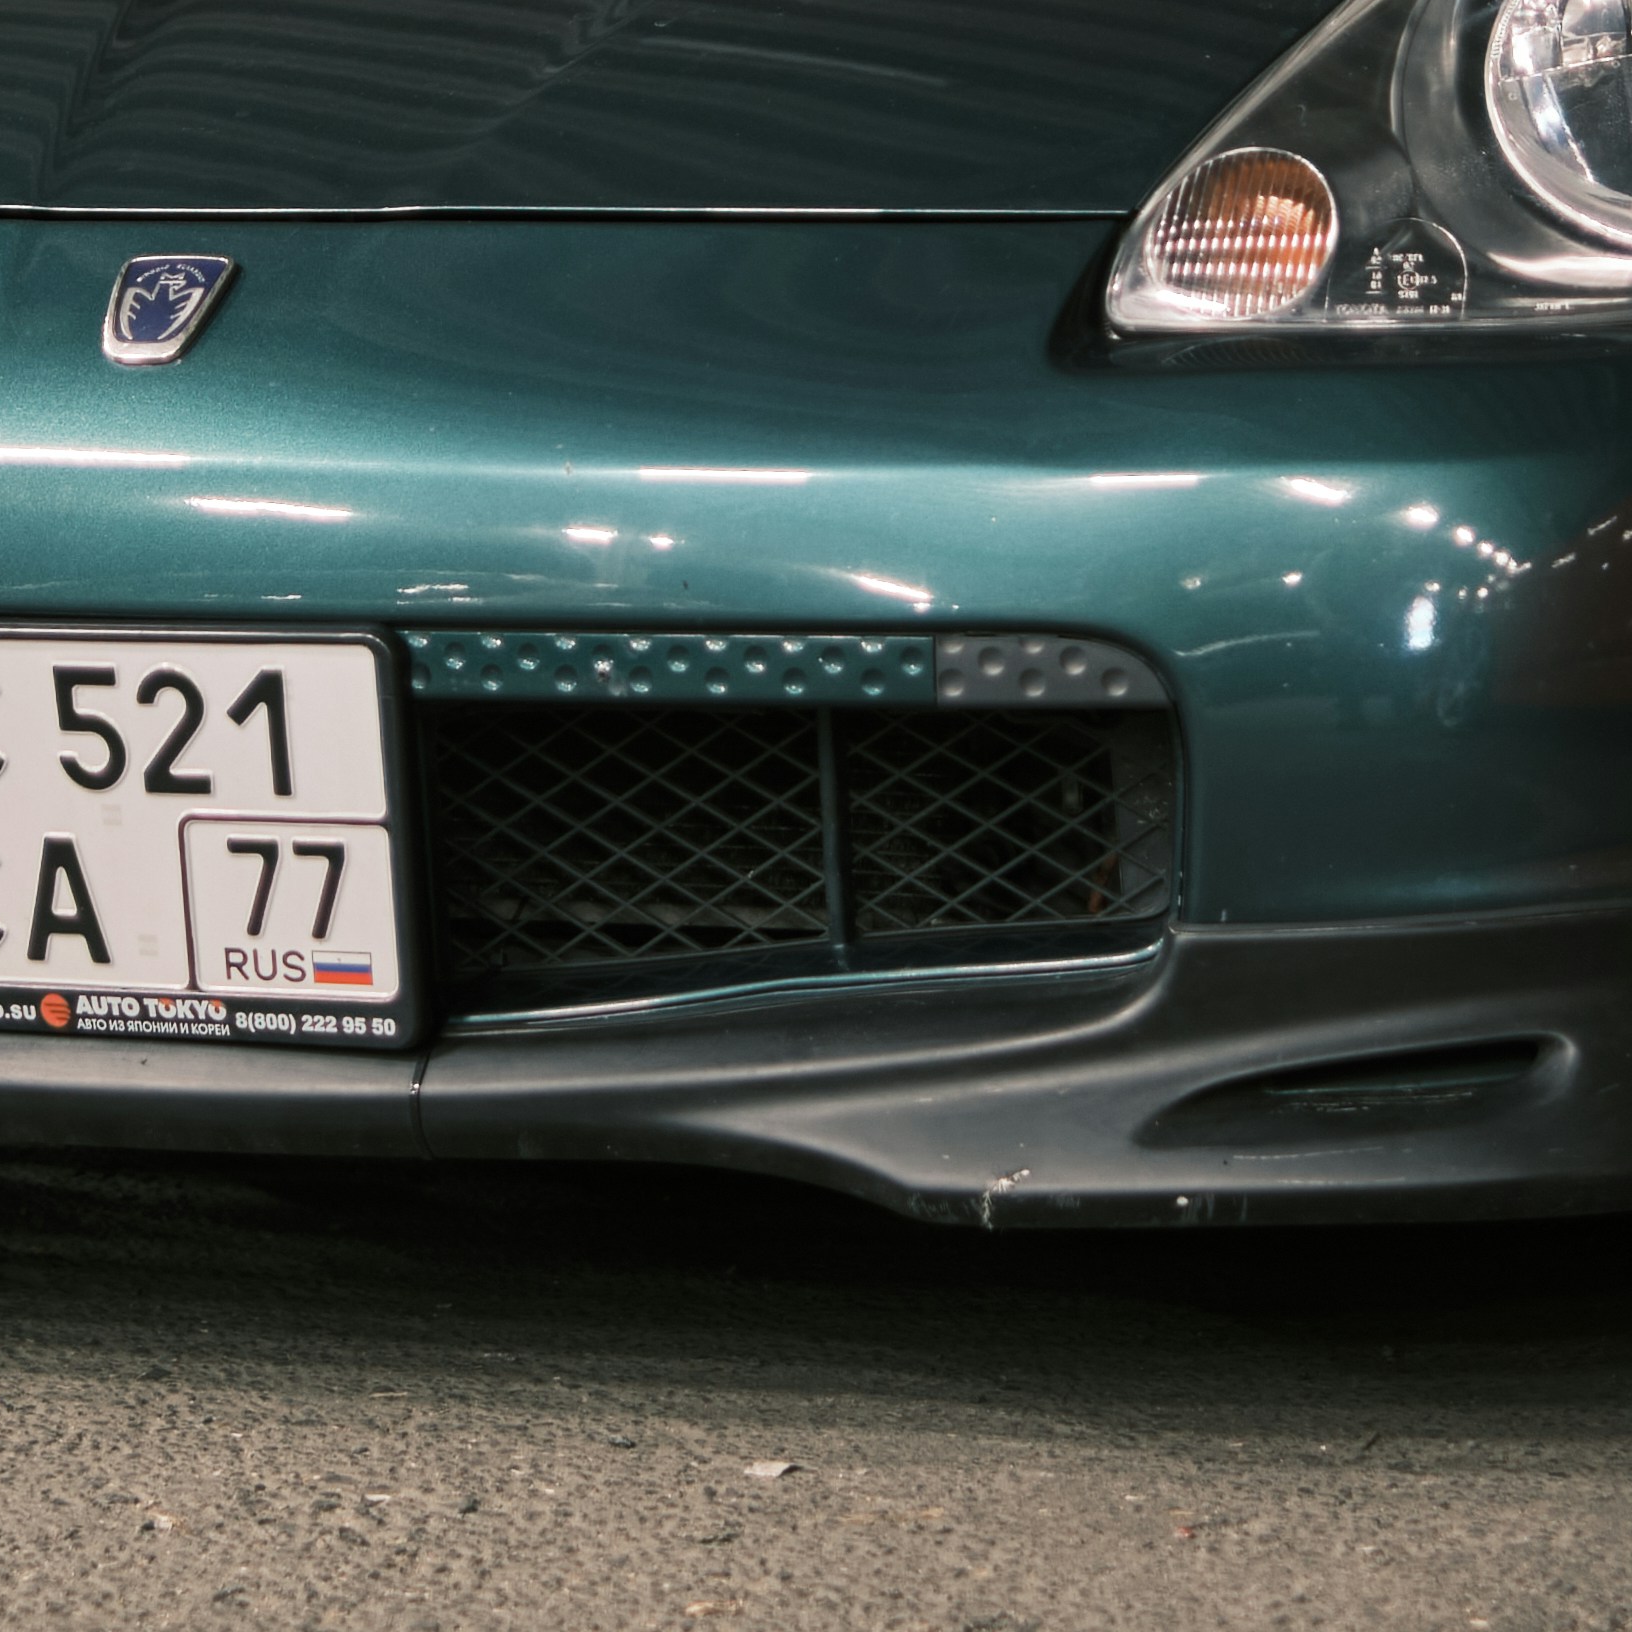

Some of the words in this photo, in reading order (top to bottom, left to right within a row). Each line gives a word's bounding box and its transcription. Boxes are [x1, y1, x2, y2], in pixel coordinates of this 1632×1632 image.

[52, 664, 294, 797] 521
[226, 836, 346, 940] 77
[224, 946, 307, 983] RUS
[75, 995, 141, 1017] AUTO
[143, 997, 228, 1020] TOKYO
[77, 1017, 108, 1031] АВТО
[109, 1019, 125, 1032] ИЗ
[126, 1019, 178, 1034] ЯПОНИИ
[179, 1022, 190, 1034] И
[191, 1023, 231, 1036] КОРЕИ
[235, 1011, 297, 1034] 8(800)
[301, 1015, 338, 1033] 222
[342, 1016, 367, 1034] 95
[371, 1017, 396, 1036] 50
